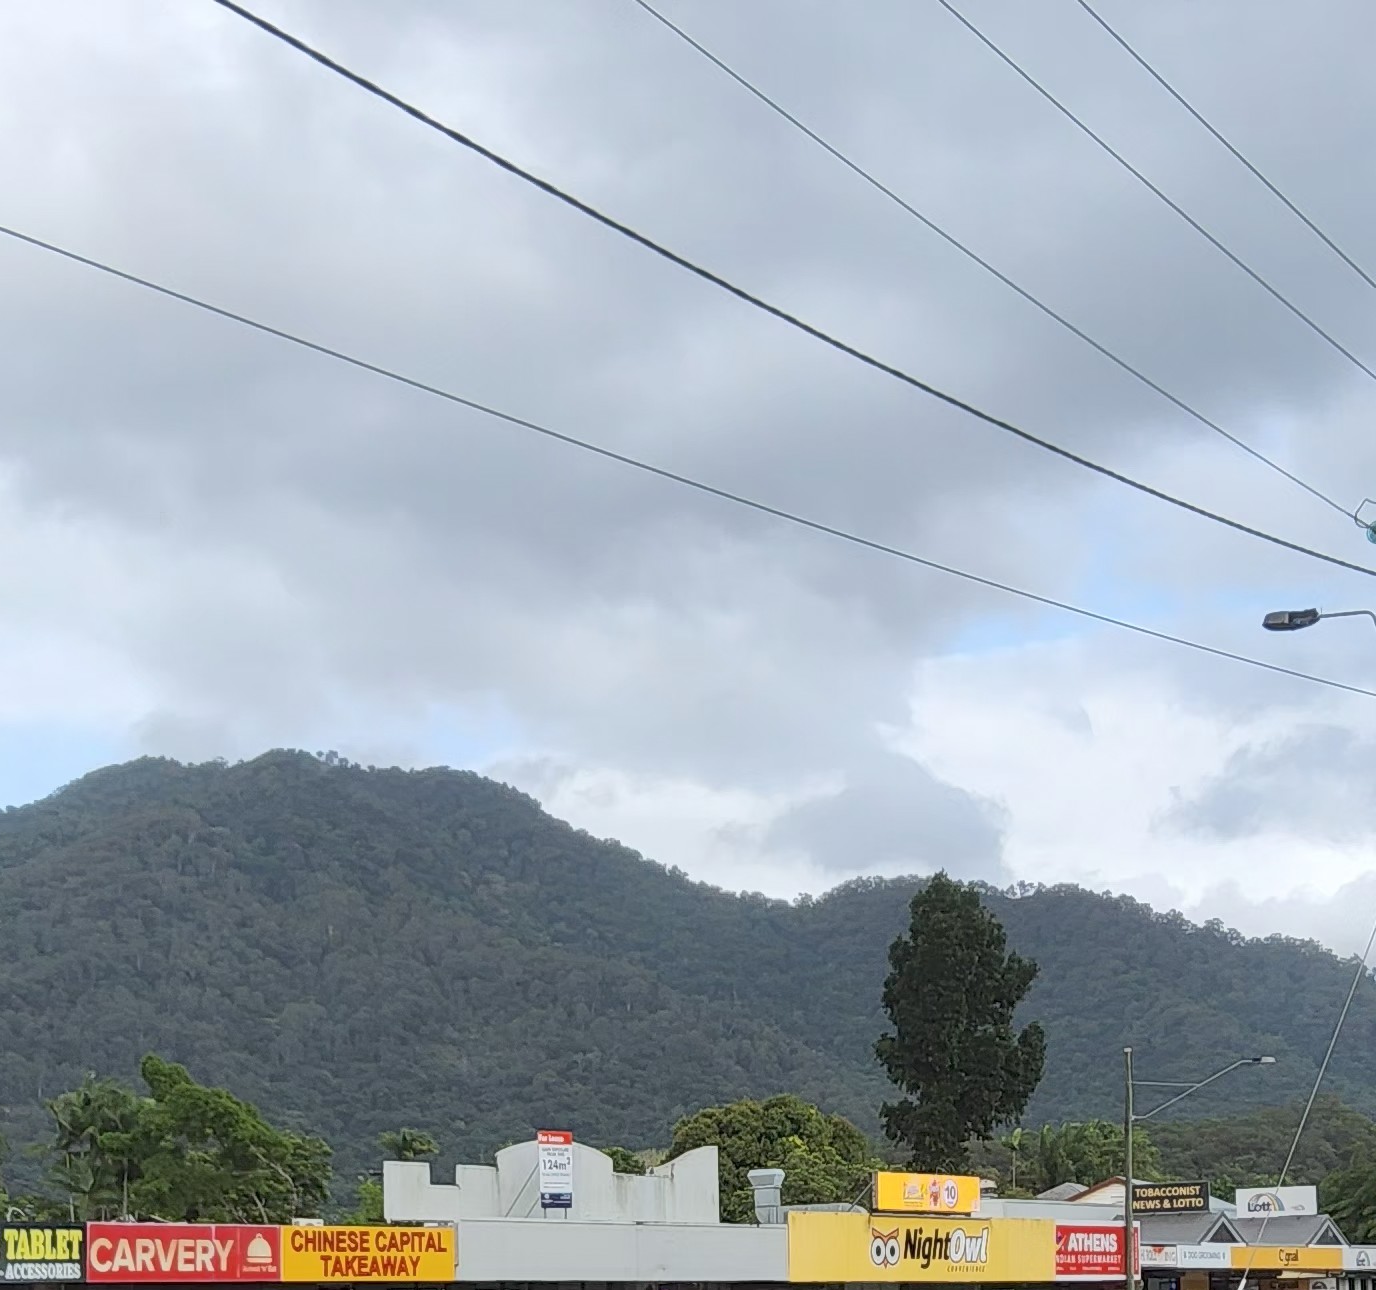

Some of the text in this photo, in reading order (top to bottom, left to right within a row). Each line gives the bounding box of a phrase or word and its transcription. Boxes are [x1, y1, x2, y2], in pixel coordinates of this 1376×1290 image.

[944, 1185, 956, 1200] 10
[1134, 1185, 1201, 1198] TOBACCONIST
[1132, 1197, 1204, 1210] NEWS & LOTTO
[4, 1228, 83, 1261] TABLET
[290, 1230, 448, 1253] CHINESE CAPITAL
[903, 1226, 989, 1270] NightOwl
[1067, 1232, 1118, 1253] ATHENS
[89, 1237, 234, 1273] CARVERY
[1056, 1254, 1122, 1264] NDIAN SUPERMARKET
[4, 1262, 82, 1280] ACCESSORIES
[320, 1255, 422, 1277] TAKEAWAY
